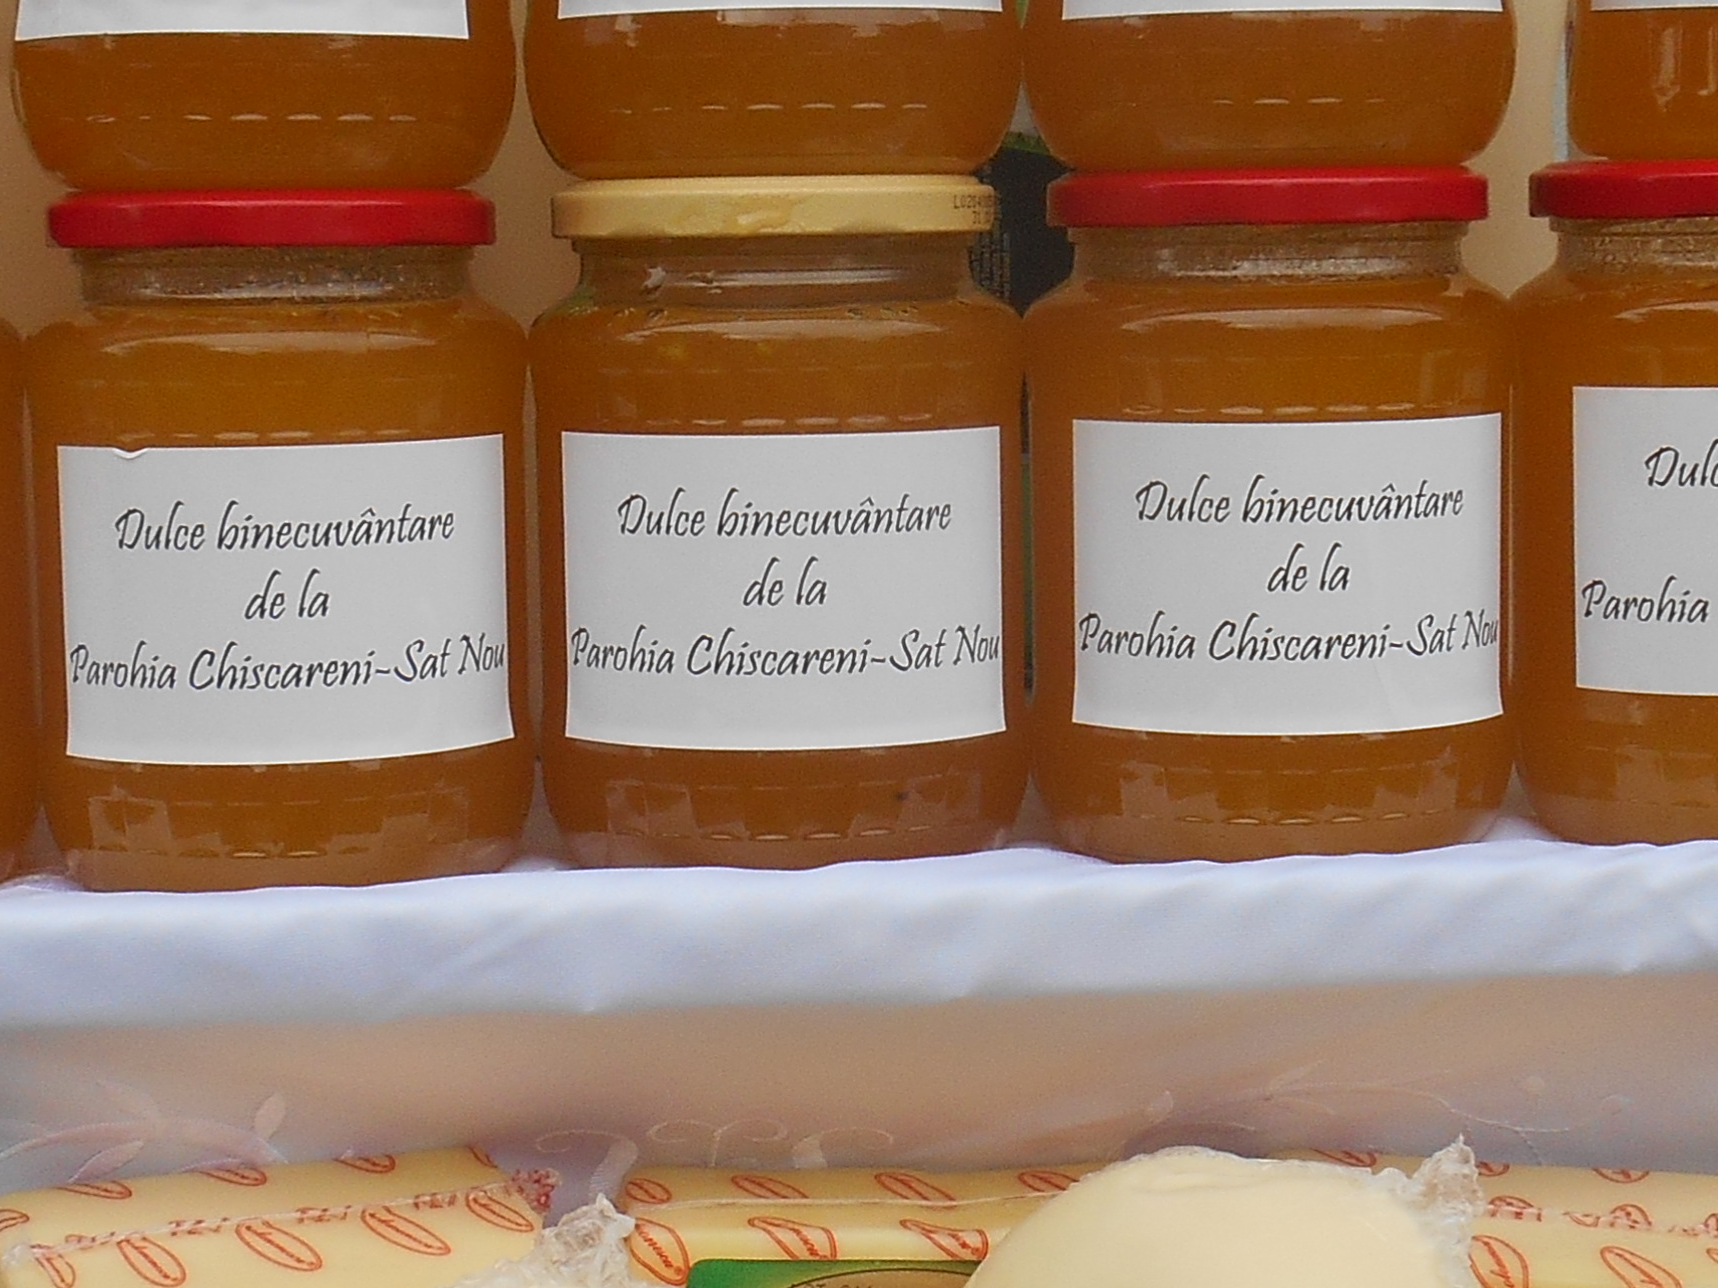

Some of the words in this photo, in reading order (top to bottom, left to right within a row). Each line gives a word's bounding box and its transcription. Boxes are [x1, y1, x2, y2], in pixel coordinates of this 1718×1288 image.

[617, 487, 705, 537] Dulce
[717, 487, 951, 538] binecuvântare
[1135, 474, 1230, 523] Dulce
[1241, 474, 1463, 524] binecuvântare
[115, 500, 205, 550] Dulce
[217, 500, 454, 550] binecuvântare
[743, 557, 784, 606] de
[796, 556, 827, 605] la
[1267, 543, 1307, 593] de
[1319, 542, 1350, 591] la
[244, 570, 285, 620] de
[298, 568, 330, 618] la
[1582, 575, 1708, 624] Parohia
[70, 641, 176, 688] Parohia
[189, 638, 451, 690] Chiscareni-Sat
[457, 633, 505, 675] Nou
[571, 625, 674, 674] Parohia
[686, 627, 946, 676] Chiscareni-Sat
[953, 624, 1000, 666] Nou
[1079, 610, 1195, 660] Parohia
[1209, 612, 1456, 662] Chiscareni-Sat
